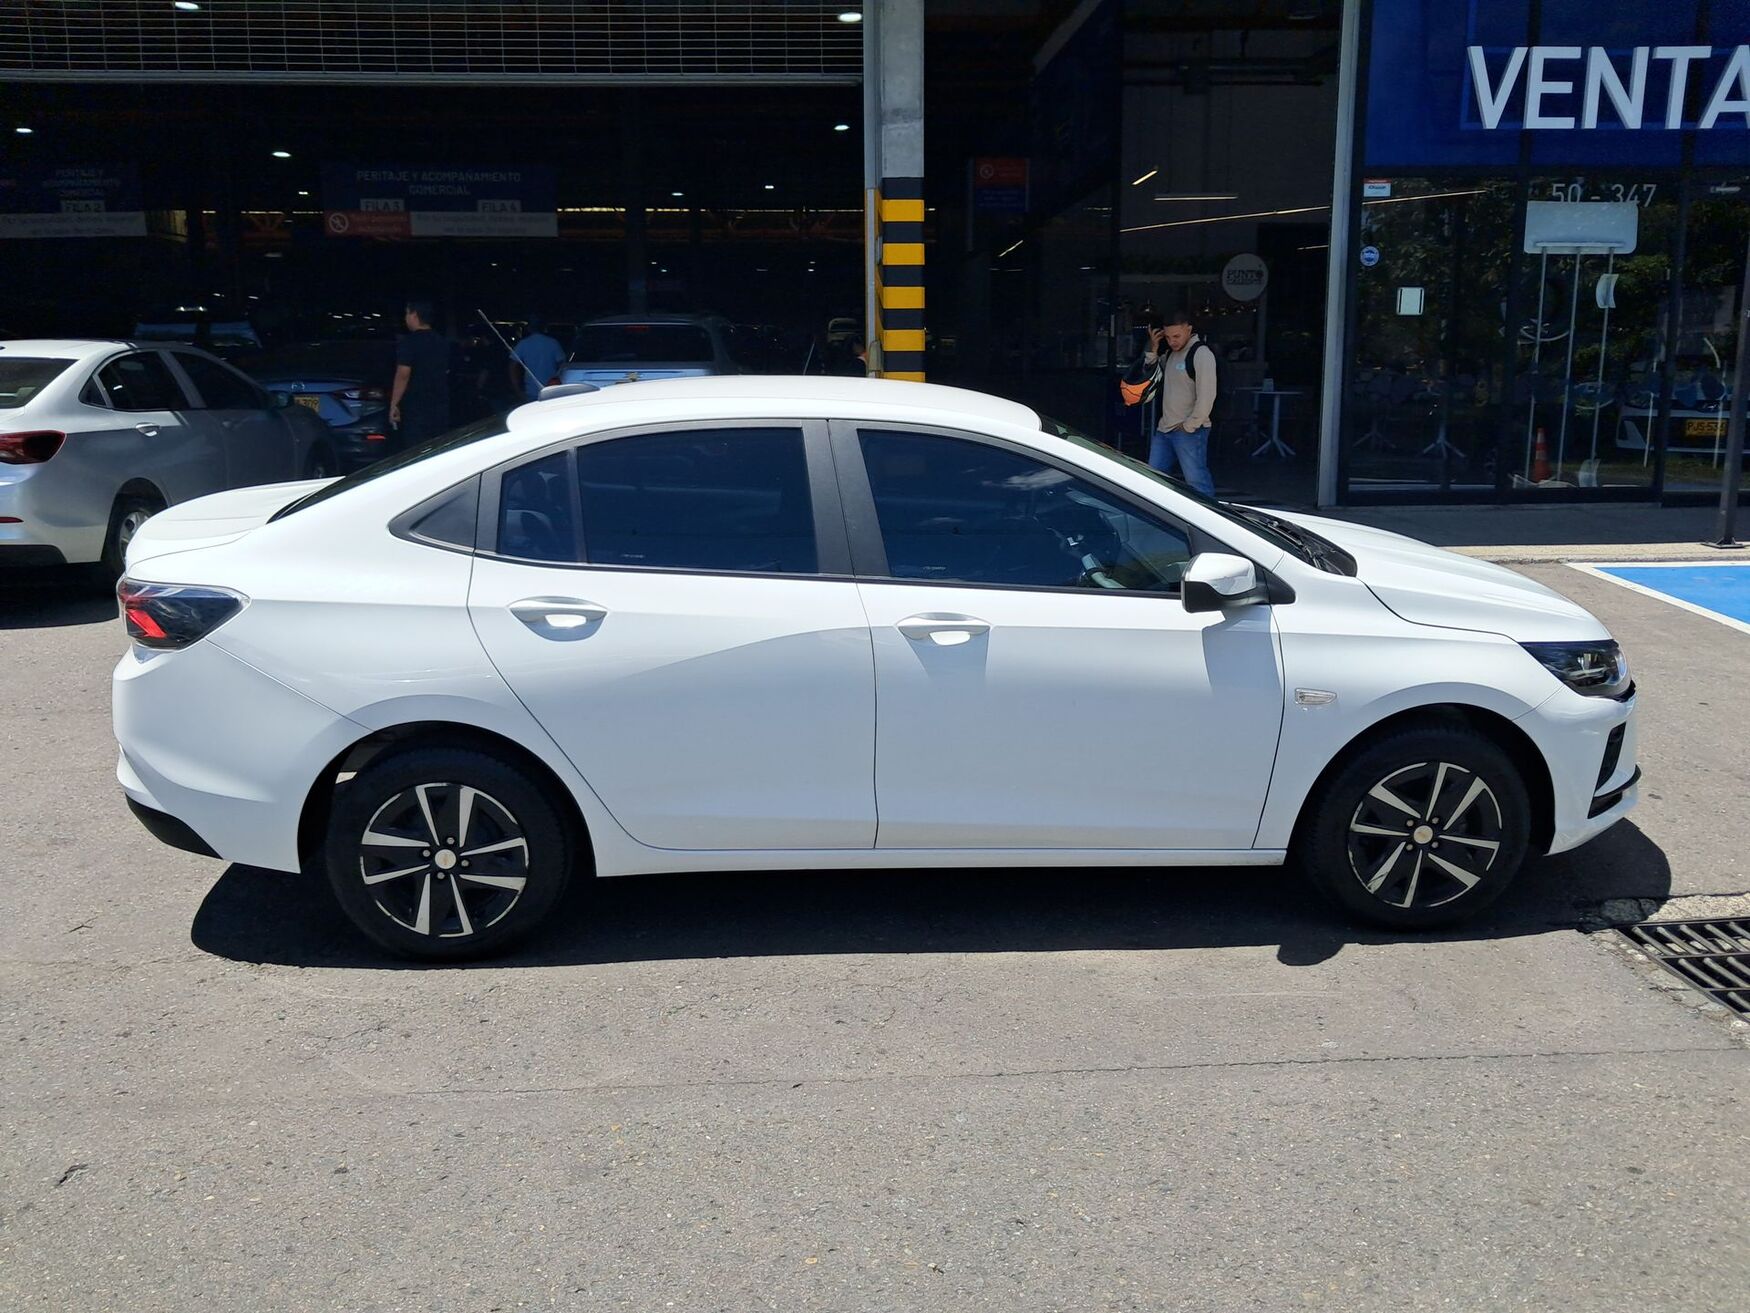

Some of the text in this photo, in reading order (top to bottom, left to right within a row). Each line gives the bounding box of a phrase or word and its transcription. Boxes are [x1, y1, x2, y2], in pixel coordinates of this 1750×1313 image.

[1467, 45, 1750, 130] VENTA
[356, 171, 409, 182] PERITAJE
[411, 171, 418, 182] Y
[408, 184, 471, 196] COMERCIAL
[1552, 183, 1582, 204] 50
[1611, 183, 1657, 208] 347
[482, 202, 508, 213] FILA
